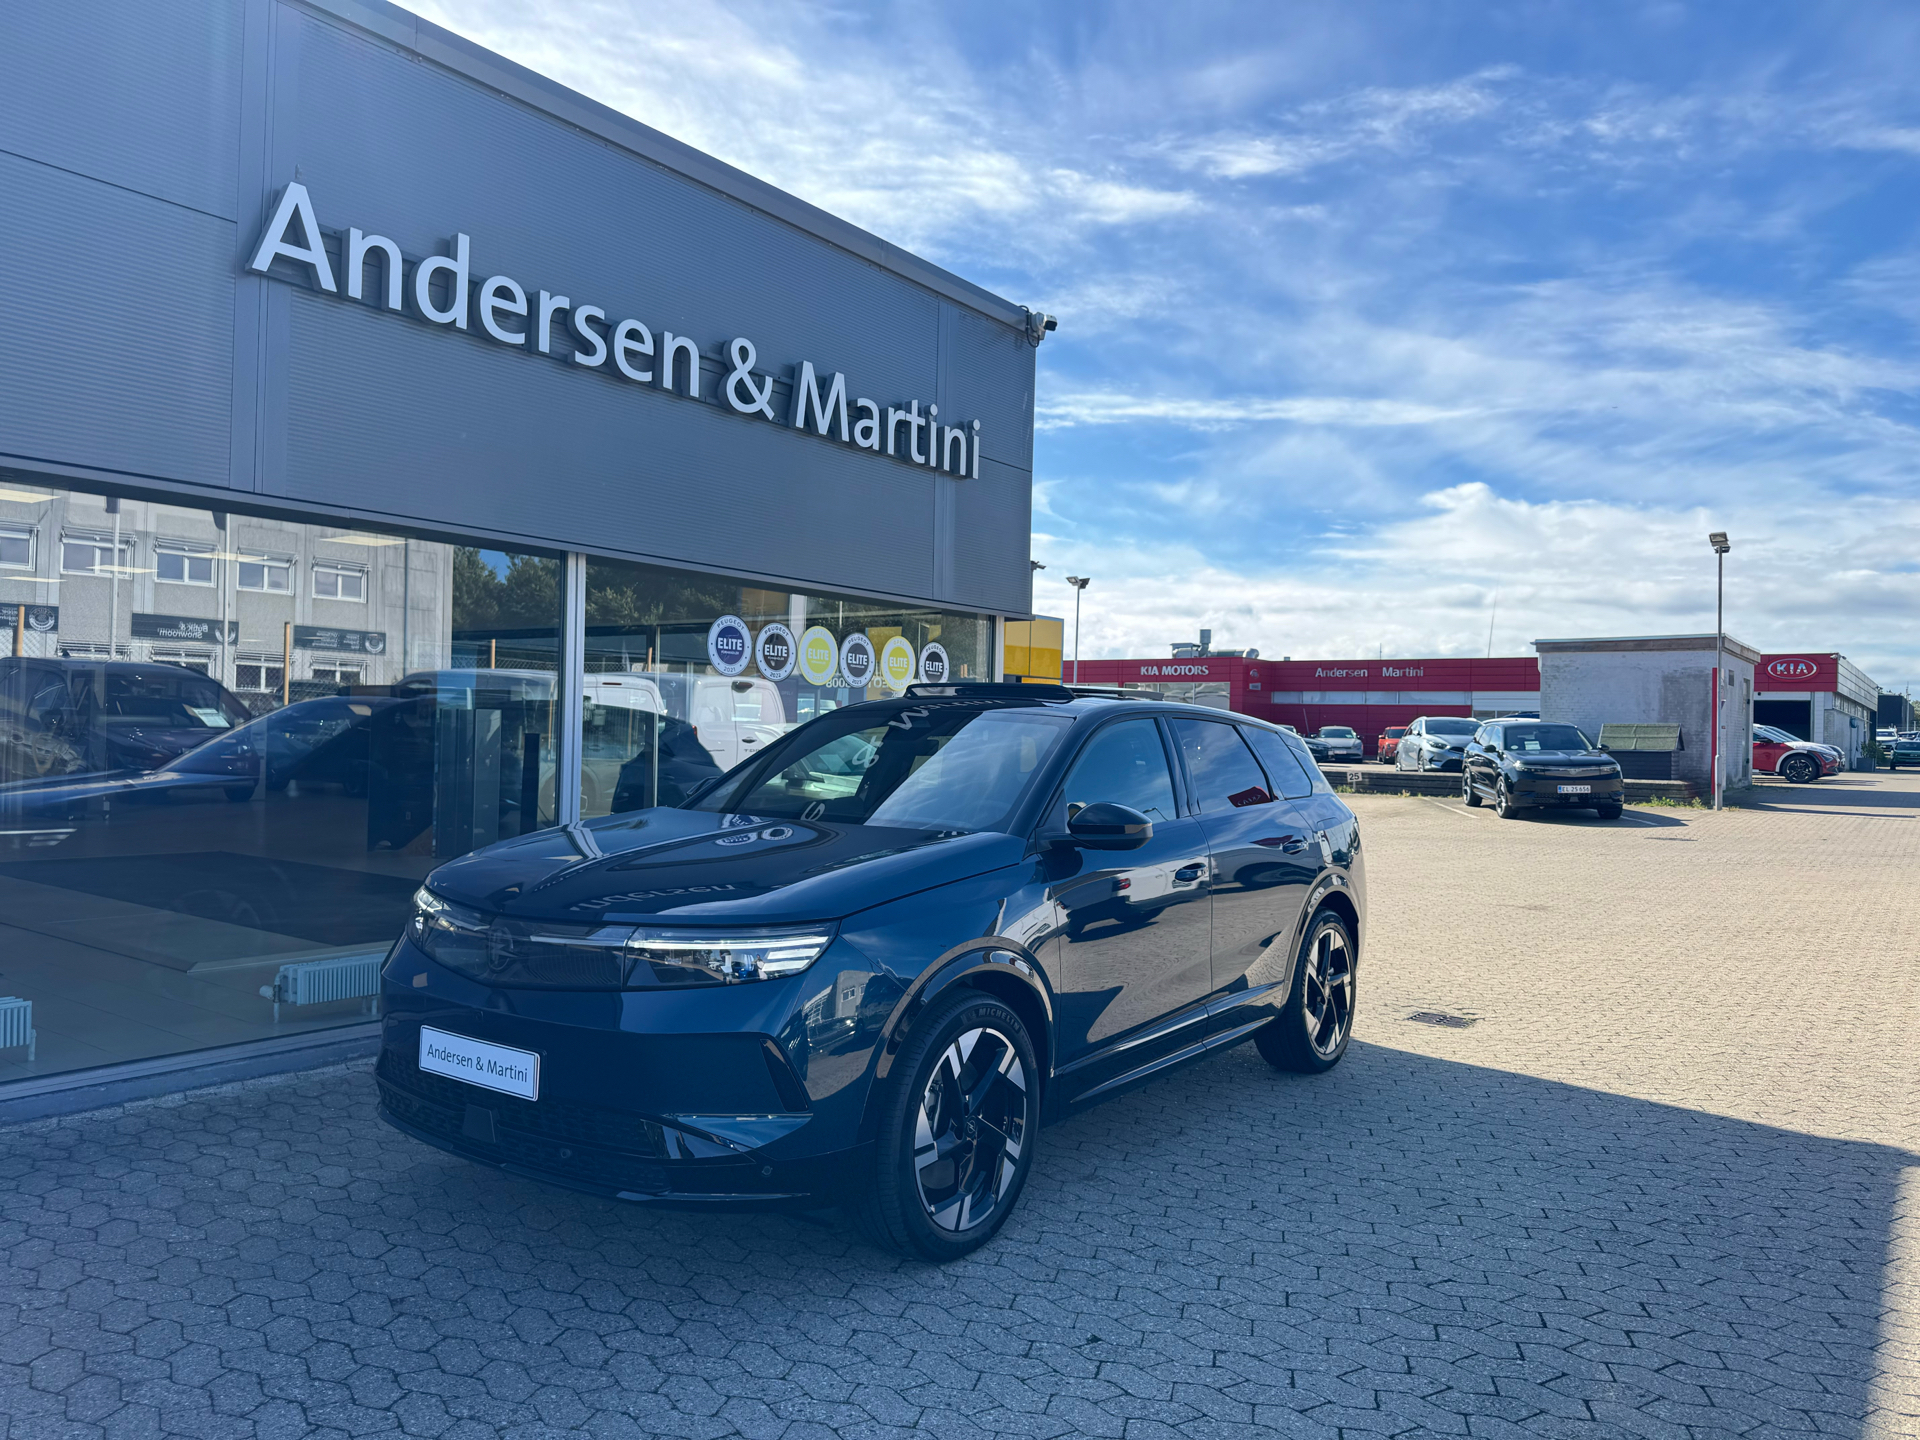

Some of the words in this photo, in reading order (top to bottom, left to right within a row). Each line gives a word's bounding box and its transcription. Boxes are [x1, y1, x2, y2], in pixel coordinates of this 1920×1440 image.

[250, 181, 700, 398] Andersen
[725, 337, 775, 420] &
[795, 360, 980, 479] Martini
[716, 618, 745, 631] PEUGEOT
[764, 625, 790, 637] PEUGEOT
[717, 637, 743, 651] ELITE
[847, 635, 870, 647] PEUGEOT
[764, 644, 788, 657] ELITE
[807, 648, 829, 661] ELITE
[925, 644, 944, 655] PEUGEOT
[847, 652, 868, 665] ELITE
[889, 656, 908, 668] ELITE
[925, 660, 943, 672] ELITE
[1140, 665, 1159, 676] KIA
[1161, 664, 1209, 676] MOTORS
[1315, 667, 1368, 678] Andersen
[1382, 666, 1424, 678] Martini
[1776, 663, 1809, 675] KIA
[1348, 772, 1360, 781] 25
[978, 1007, 1020, 1031] MICHELIN
[427, 1043, 473, 1069] Andersen
[475, 1056, 484, 1072] &
[486, 1059, 528, 1083] Martini
